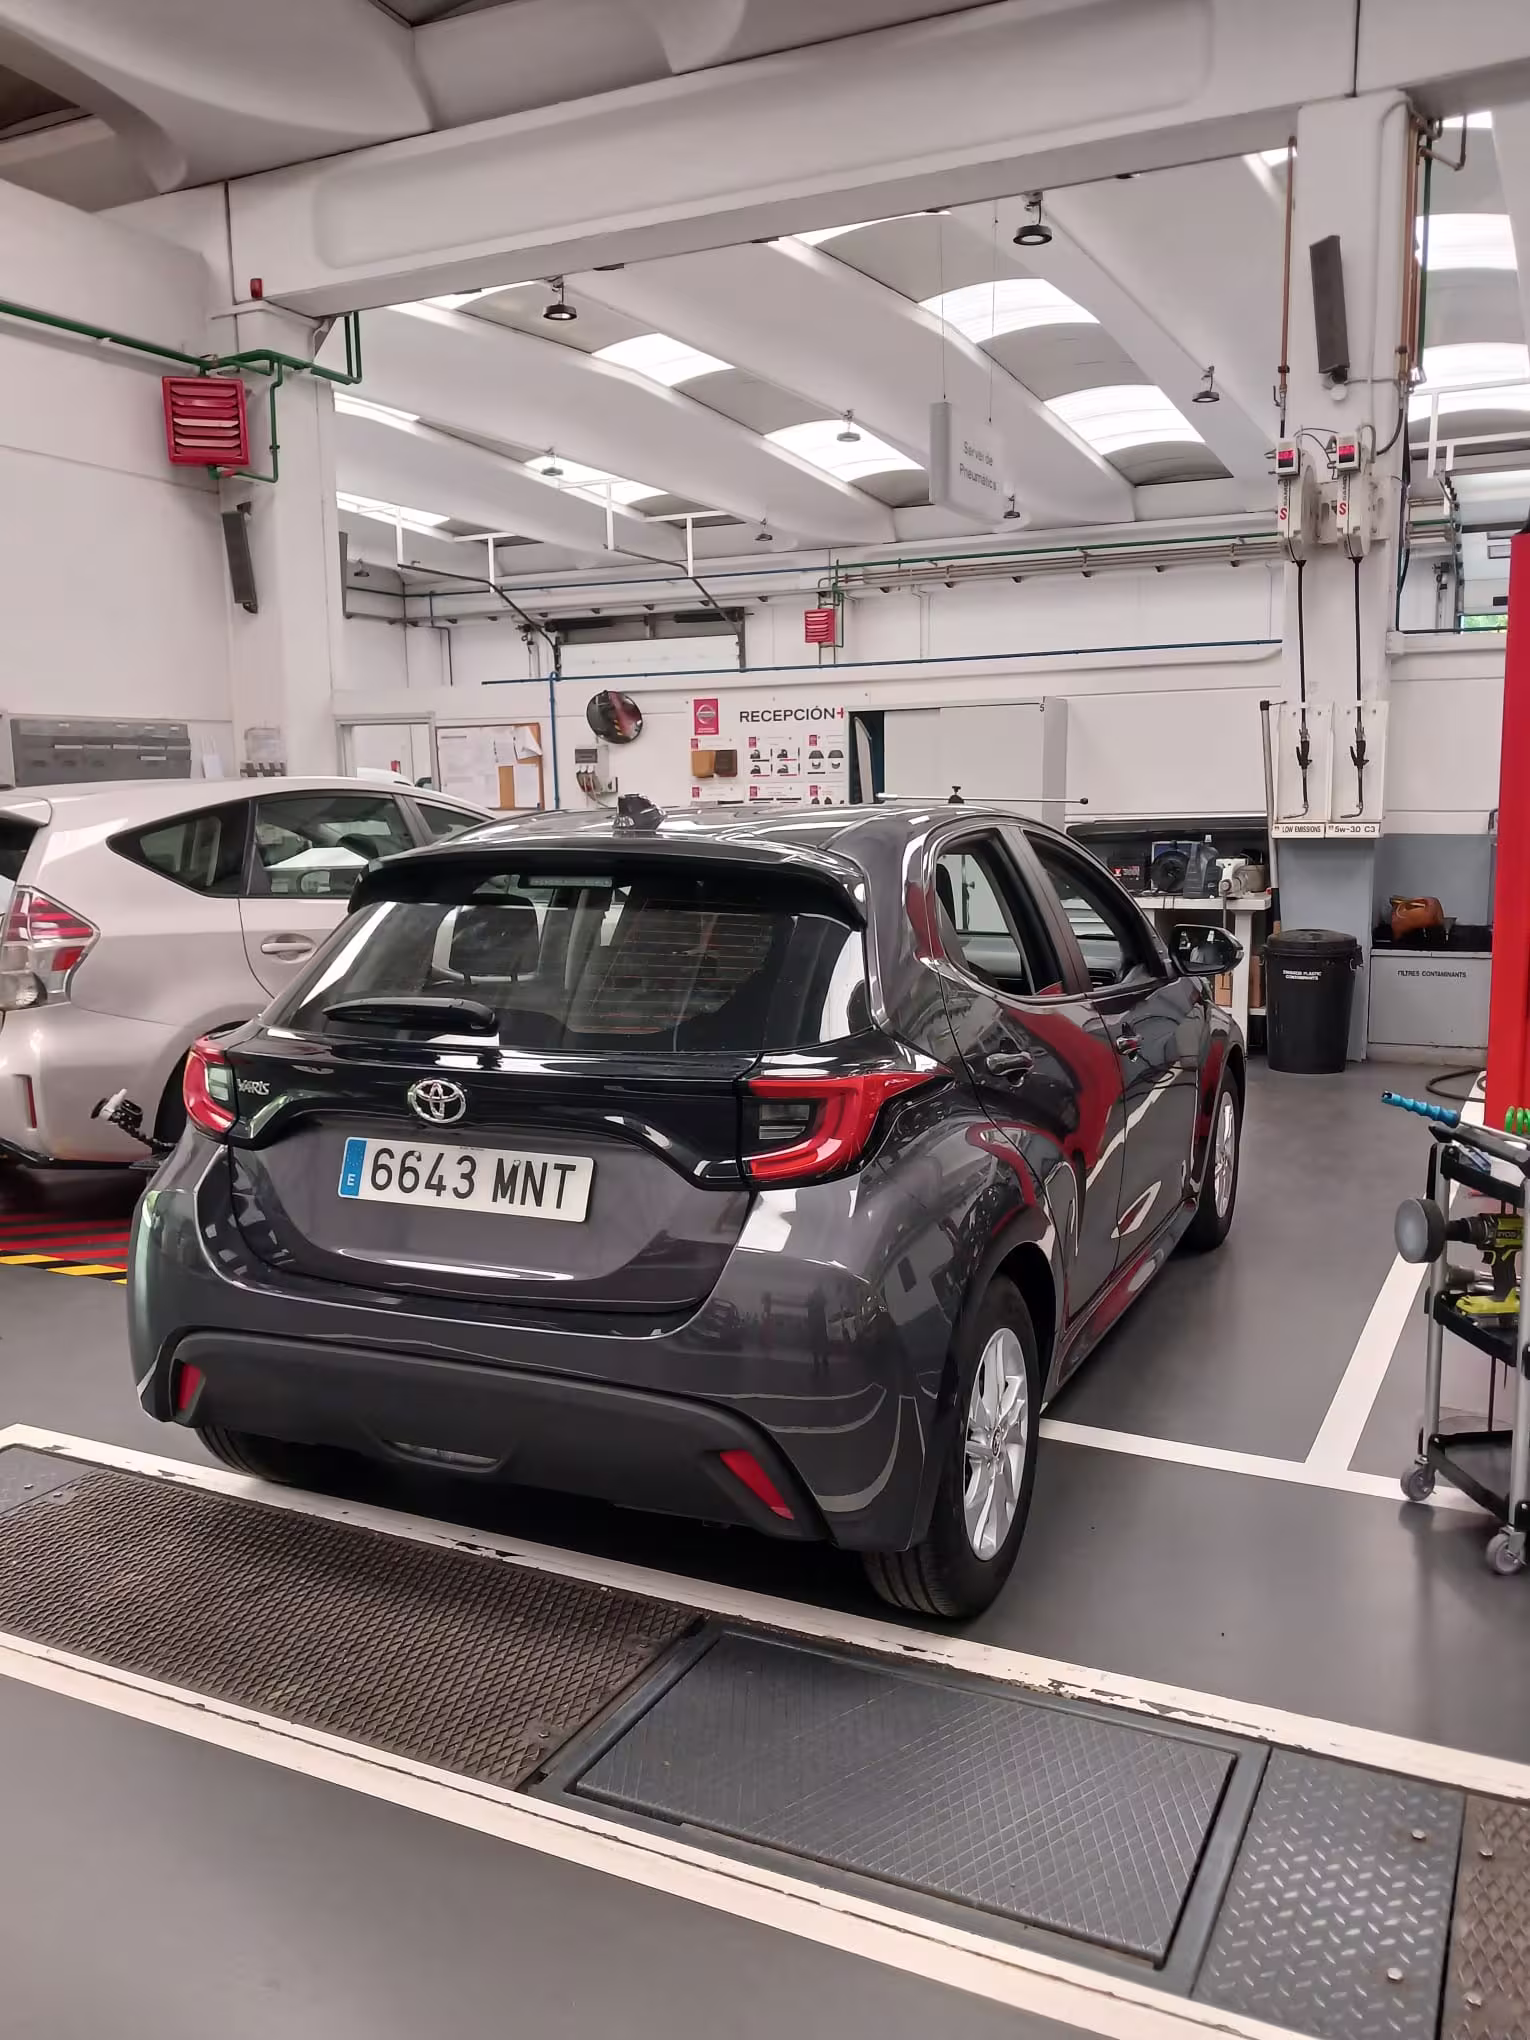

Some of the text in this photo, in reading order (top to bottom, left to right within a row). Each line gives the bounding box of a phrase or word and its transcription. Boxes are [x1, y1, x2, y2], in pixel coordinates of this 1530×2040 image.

[1282, 825, 1322, 833] LOW EMISSIONS
[1364, 825, 1376, 833] C3
[1421, 970, 1467, 978] CONTAMINANTS
[346, 1173, 356, 1187] E
[370, 1147, 577, 1210] 6643 MNT
